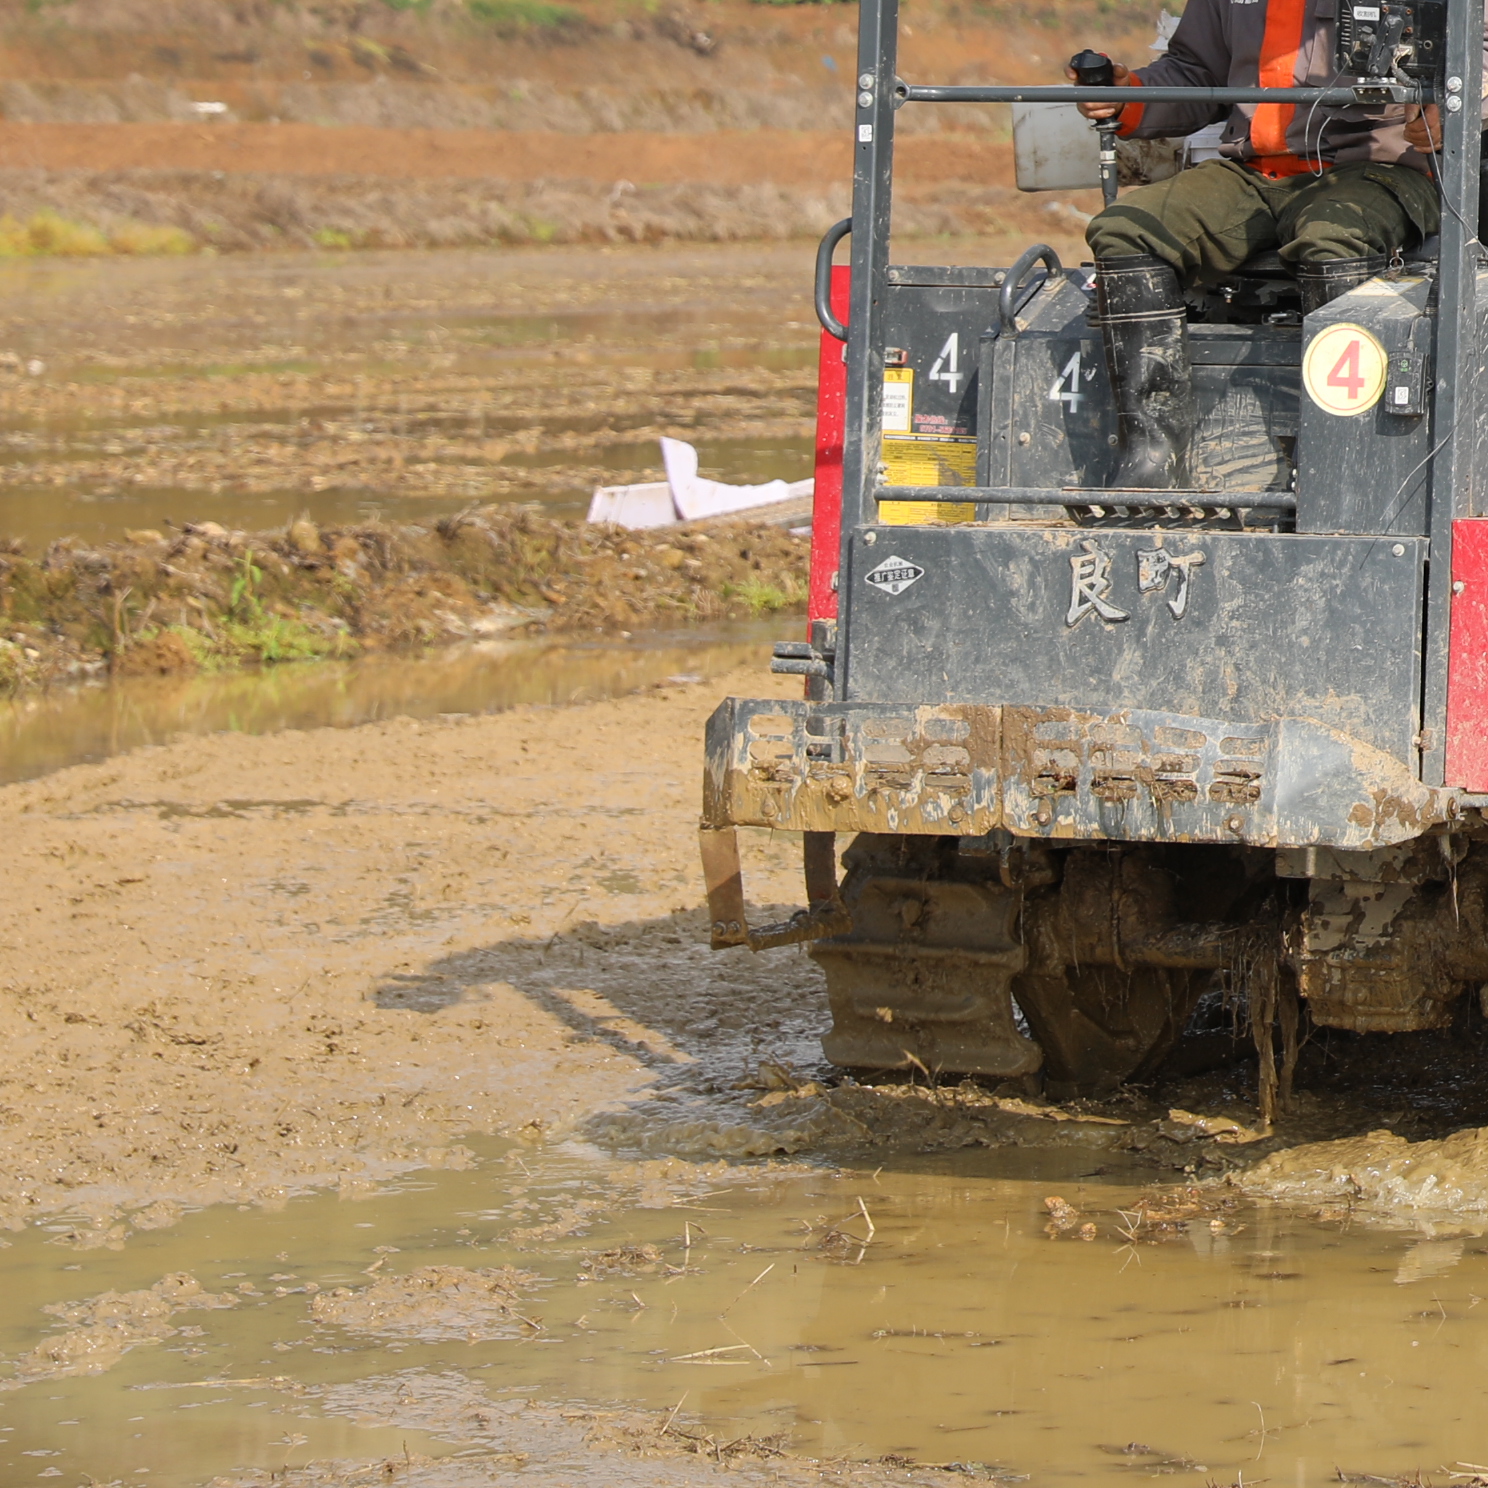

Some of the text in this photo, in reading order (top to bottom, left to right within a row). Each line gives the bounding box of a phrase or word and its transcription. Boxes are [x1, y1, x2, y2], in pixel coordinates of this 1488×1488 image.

[929, 332, 963, 393] 4
[1049, 351, 1083, 413] 4
[1326, 340, 1365, 399] 4
[1065, 538, 1207, 628] 良町
